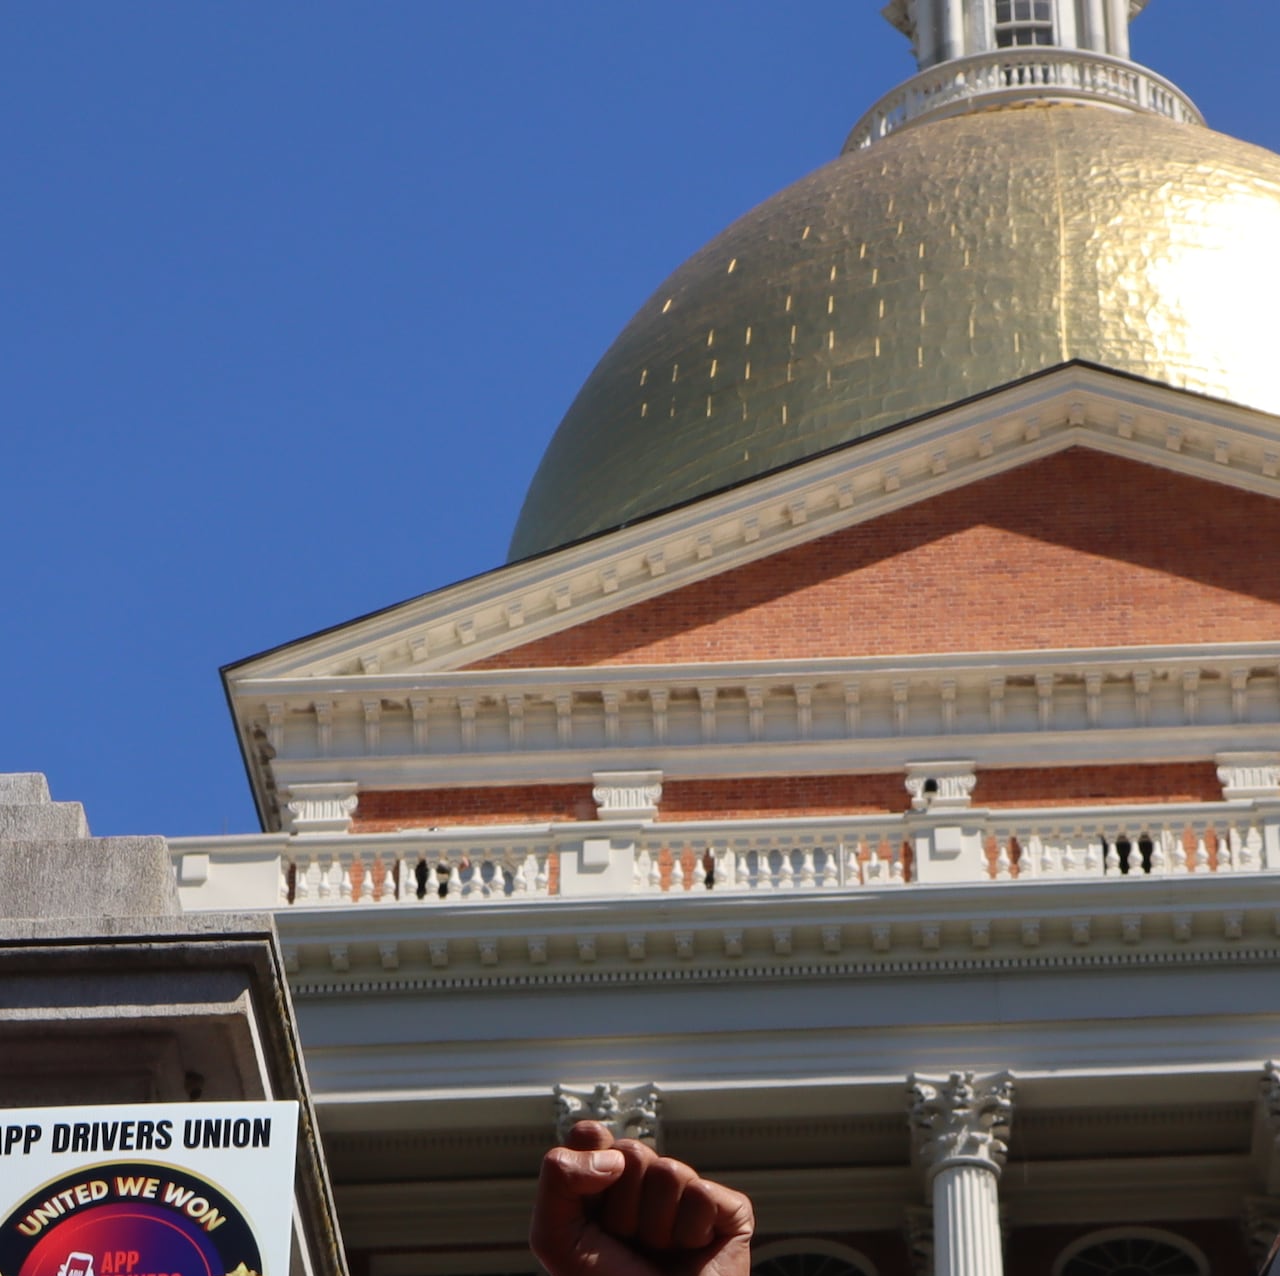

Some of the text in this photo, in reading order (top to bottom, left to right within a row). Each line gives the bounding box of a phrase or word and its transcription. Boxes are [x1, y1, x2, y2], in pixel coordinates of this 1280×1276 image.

[51, 1119, 173, 1153] DRIVERS
[183, 1118, 271, 1149] UNION
[18, 1177, 226, 1237] UNITED WE WON
[101, 1251, 140, 1273] APP
